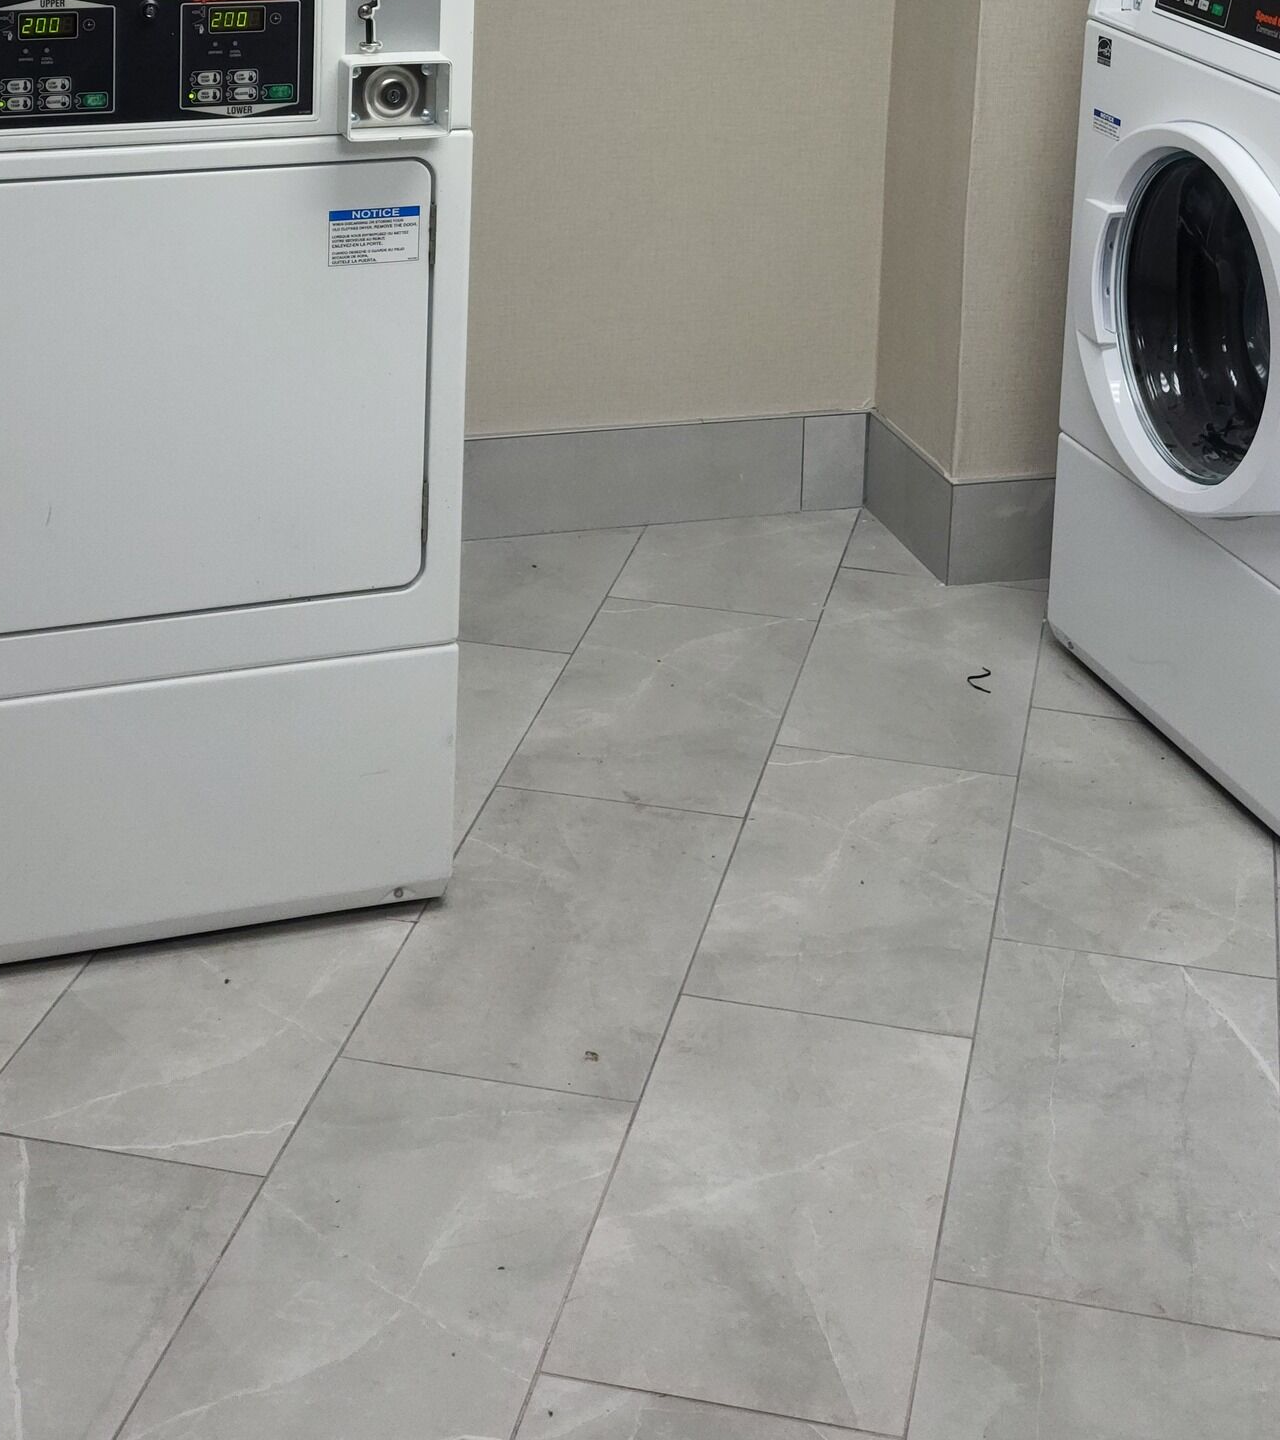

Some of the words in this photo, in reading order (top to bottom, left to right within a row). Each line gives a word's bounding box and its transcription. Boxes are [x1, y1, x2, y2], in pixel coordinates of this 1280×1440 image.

[40, 0, 65, 8] UPPER
[1255, 9, 1278, 26] Speed
[227, 106, 253, 114] LOWER
[351, 208, 400, 219] NOTICE
